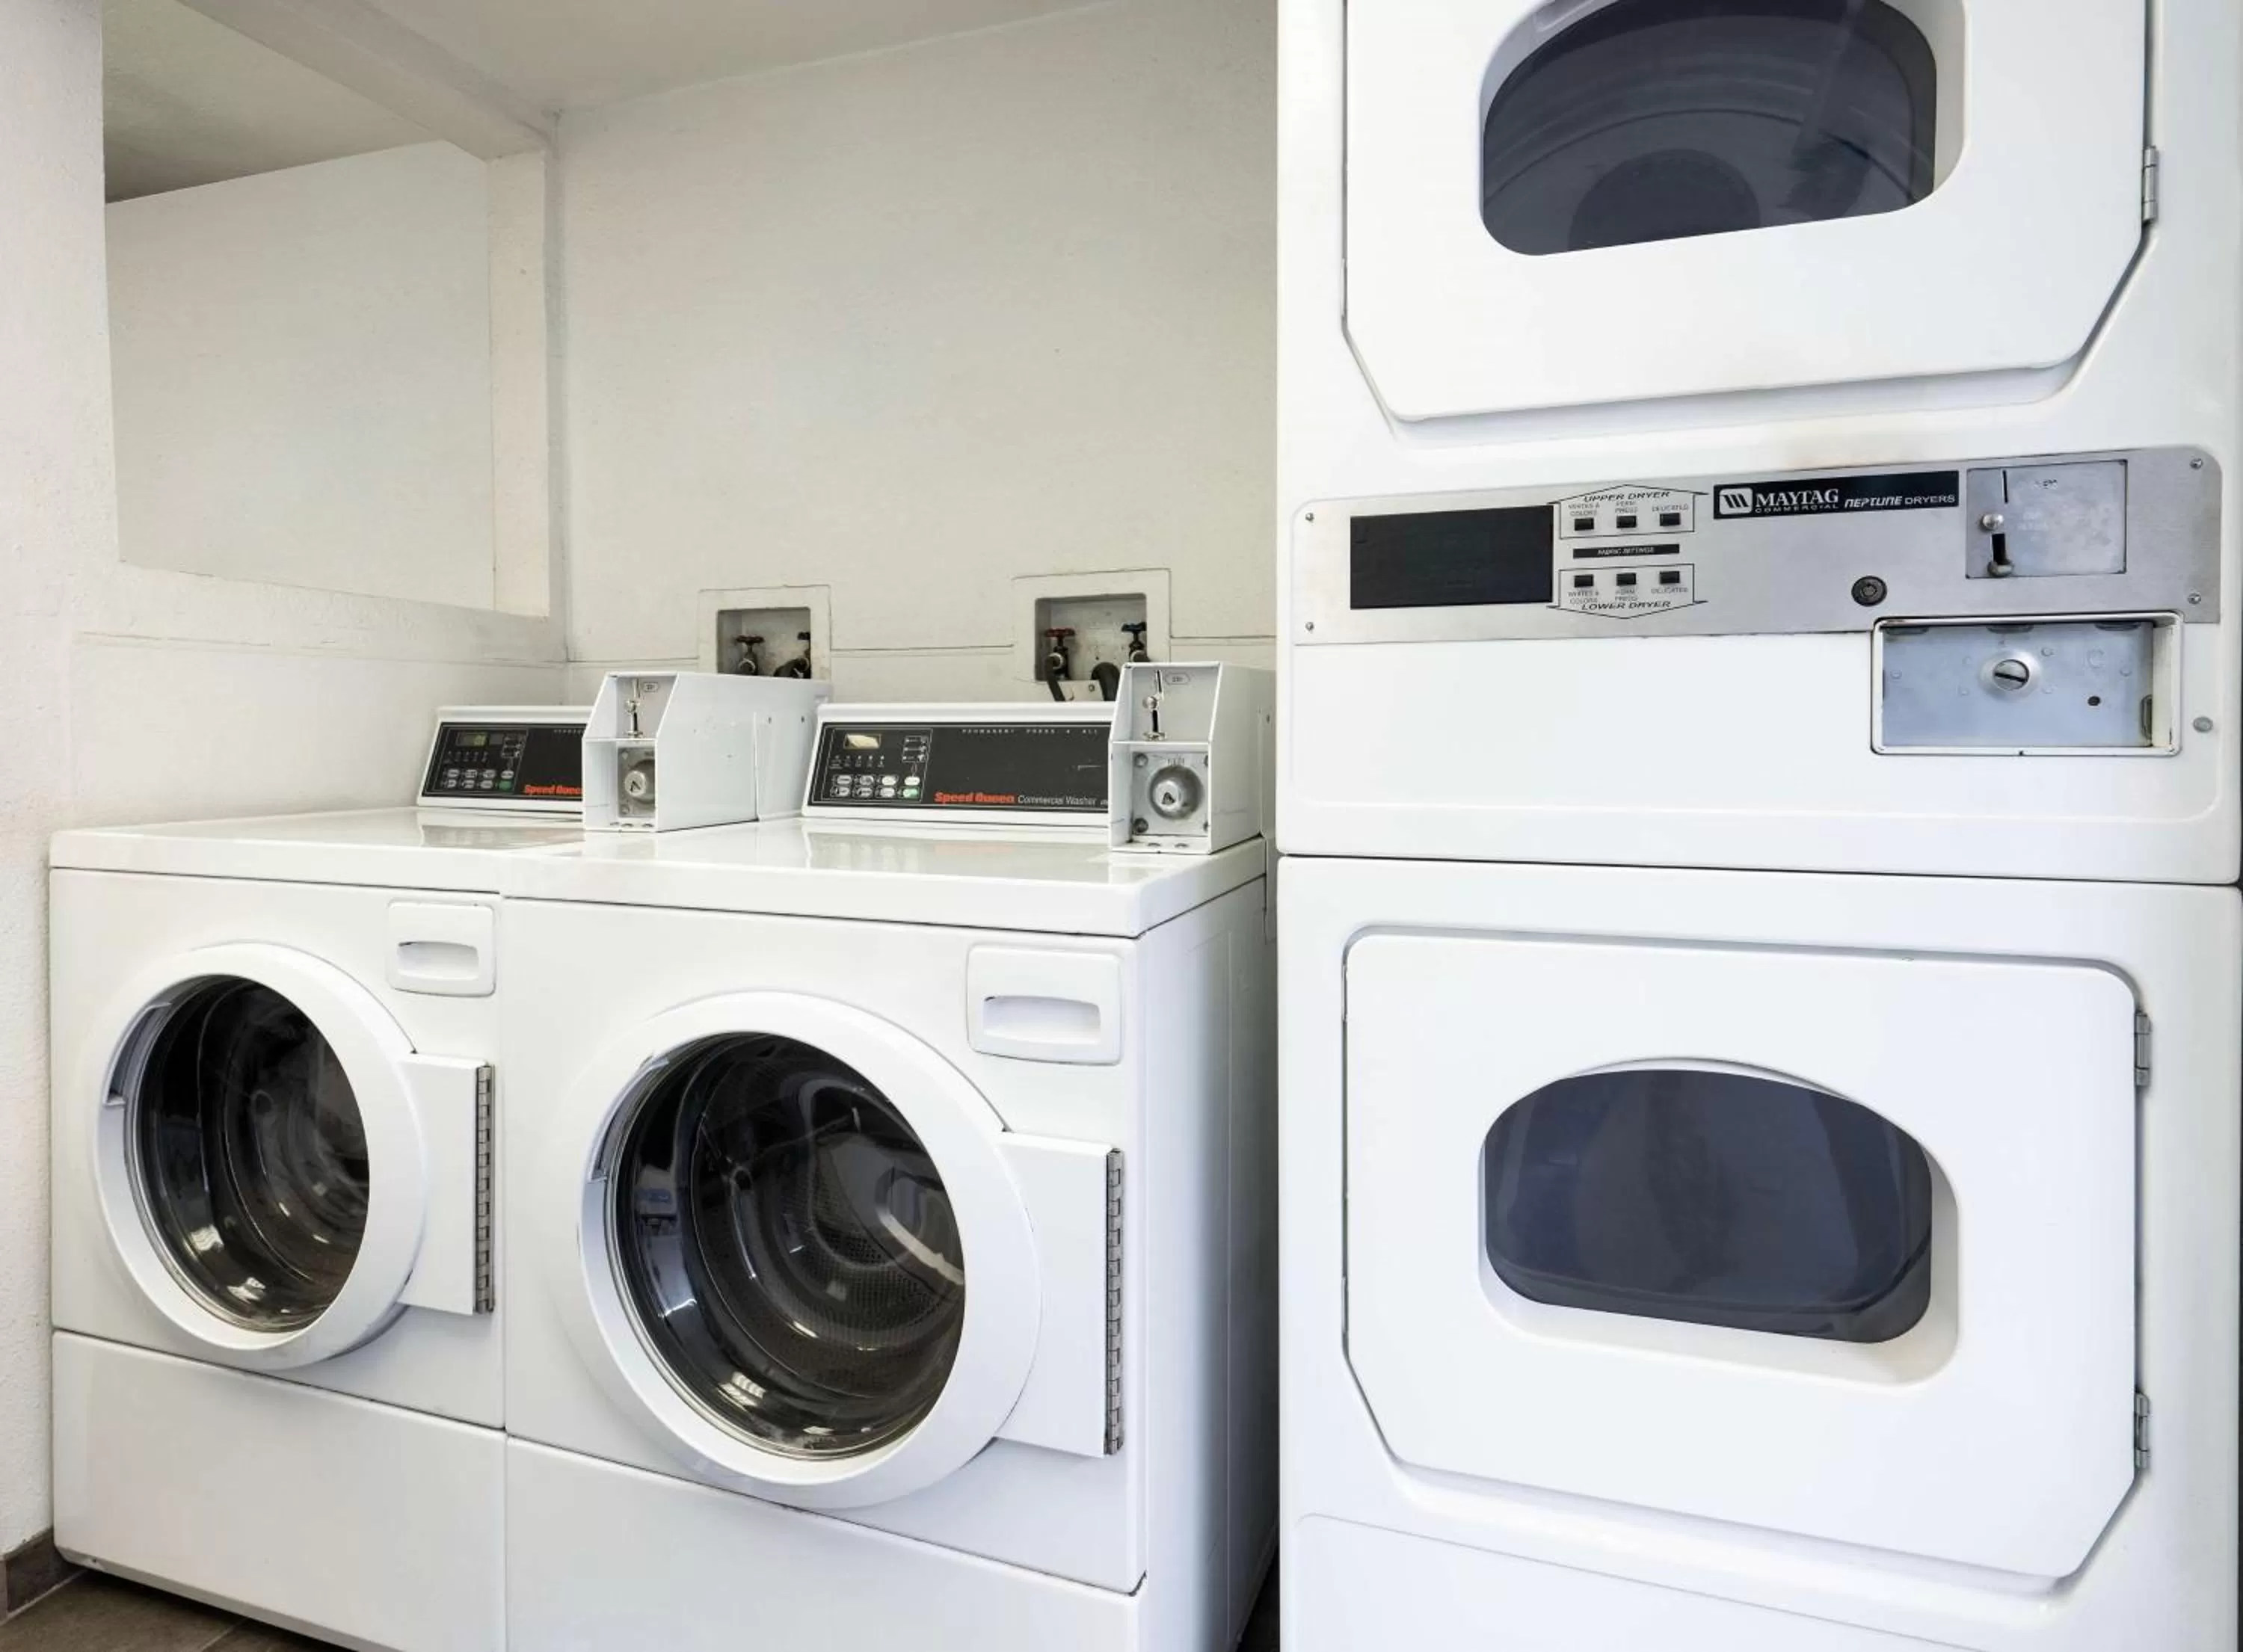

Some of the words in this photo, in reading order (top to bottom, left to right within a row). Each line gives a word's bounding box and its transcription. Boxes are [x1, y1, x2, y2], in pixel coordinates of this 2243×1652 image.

[1584, 493, 1625, 502] UPPER
[1628, 491, 1670, 499] DRYER
[1756, 489, 1839, 508] MAYTAG
[1904, 494, 1955, 505] DRYERS
[1755, 505, 1839, 514] COMMERCIAL
[1581, 602, 1625, 610] LOWER
[1628, 600, 1671, 609] DRYER
[526, 784, 555, 795] Speed
[935, 792, 973, 804] Speed
[975, 792, 1015, 804] Queen
[1018, 795, 1064, 805] Commercial
[1065, 795, 1096, 806] Washer
